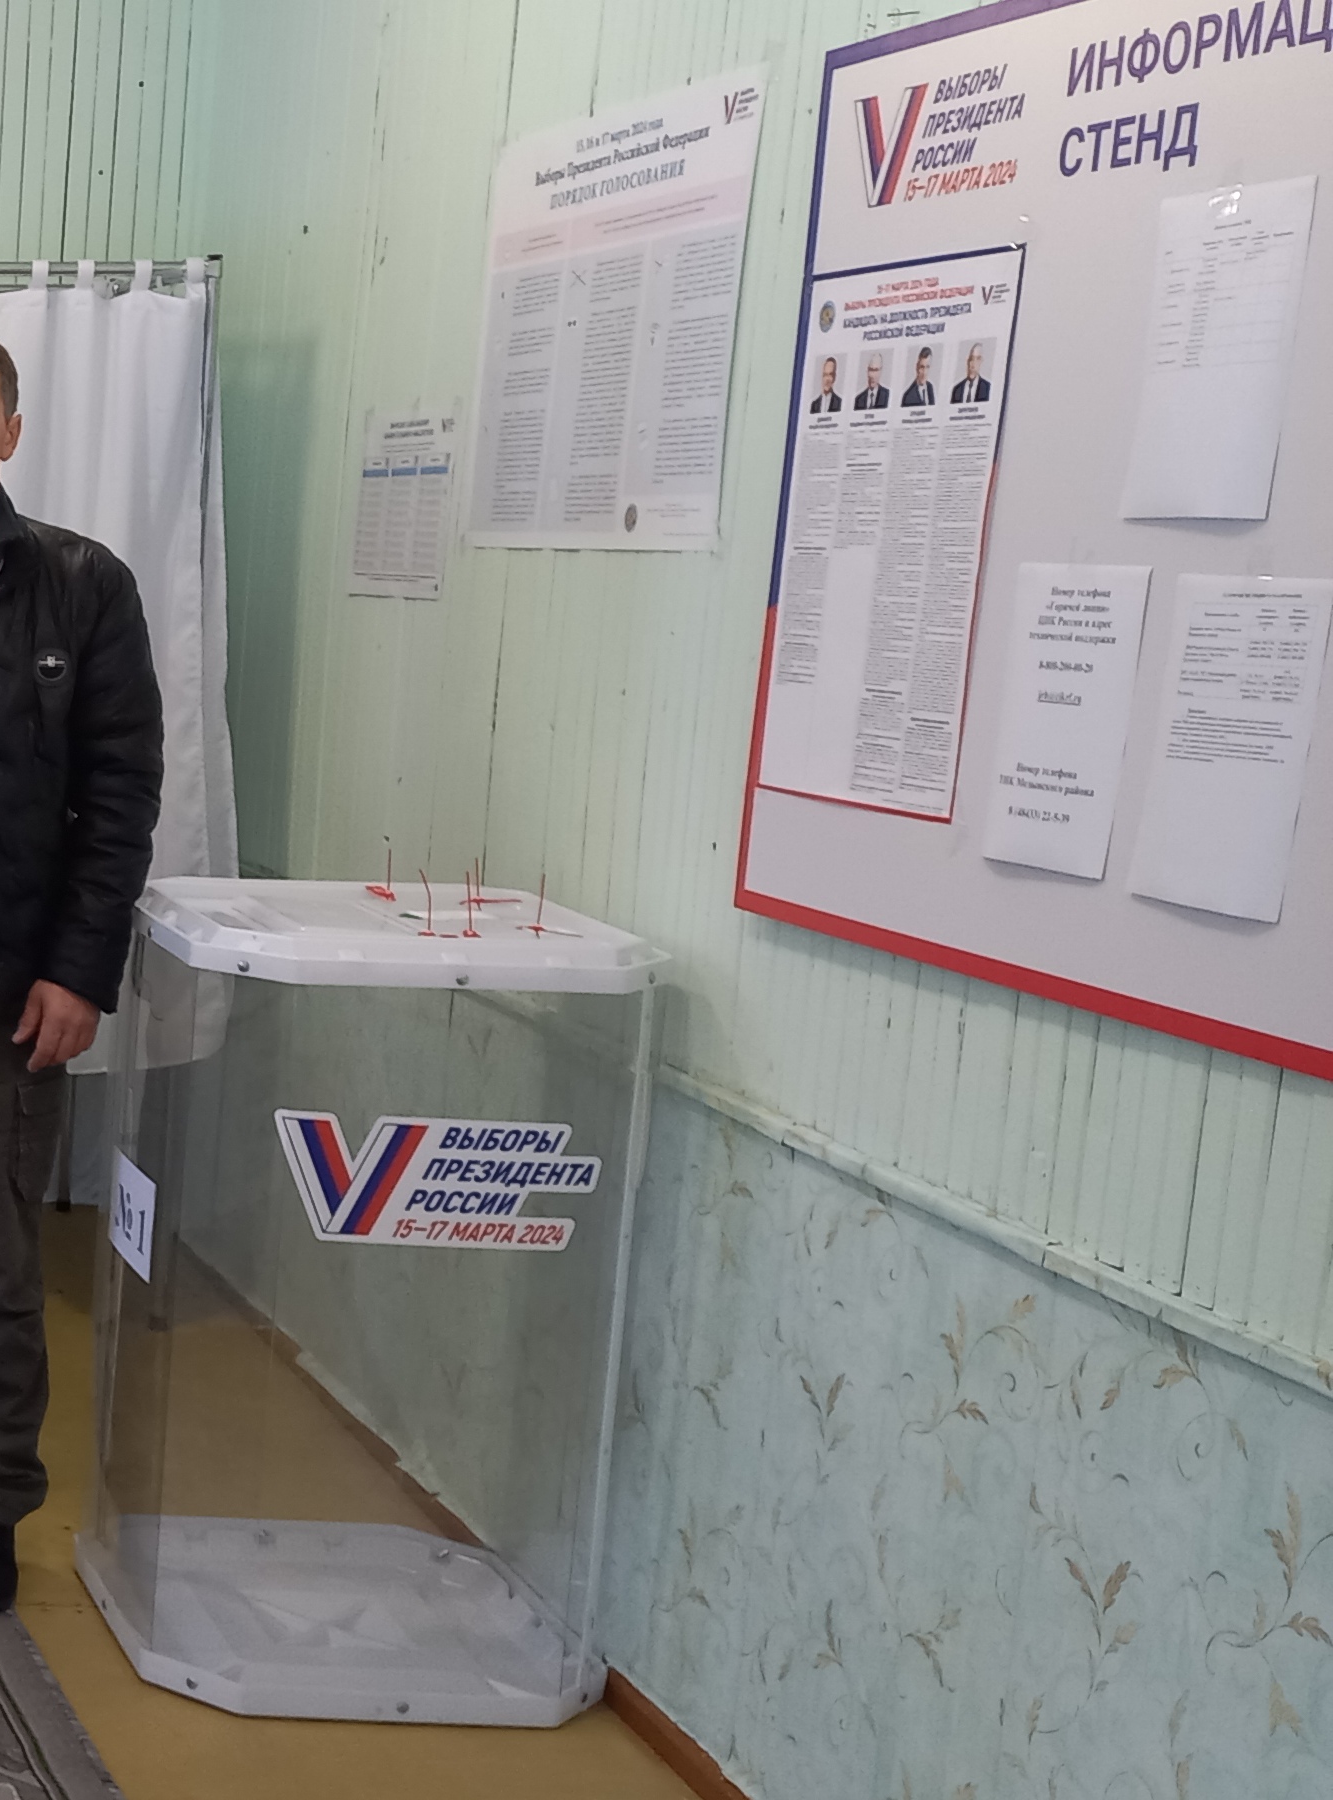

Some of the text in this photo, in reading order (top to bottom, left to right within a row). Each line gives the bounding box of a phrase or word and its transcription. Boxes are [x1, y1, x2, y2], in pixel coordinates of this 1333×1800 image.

[1067, 0, 1333, 97] ИНФОРМАЦ
[933, 63, 1008, 104] ВЫБОРЫ
[922, 93, 1025, 139] ПРЕЗИДЕНТА
[911, 137, 978, 173] РОССИИ
[1059, 103, 1199, 177] СТЕНД
[549, 159, 685, 210] ПОРЯДОК ГОЛОСОВАНИЯ
[937, 166, 984, 196] МАРТА
[983, 159, 1018, 188] 2024
[439, 1126, 566, 1154] ВЫБОРЫ
[421, 1157, 595, 1189] ПРЕЗИДЕНТА
[114, 1182, 146, 1256] № 1
[404, 1189, 521, 1216] РОССИИ
[448, 1221, 517, 1244] МАРТА
[516, 1223, 565, 1246] 2024
